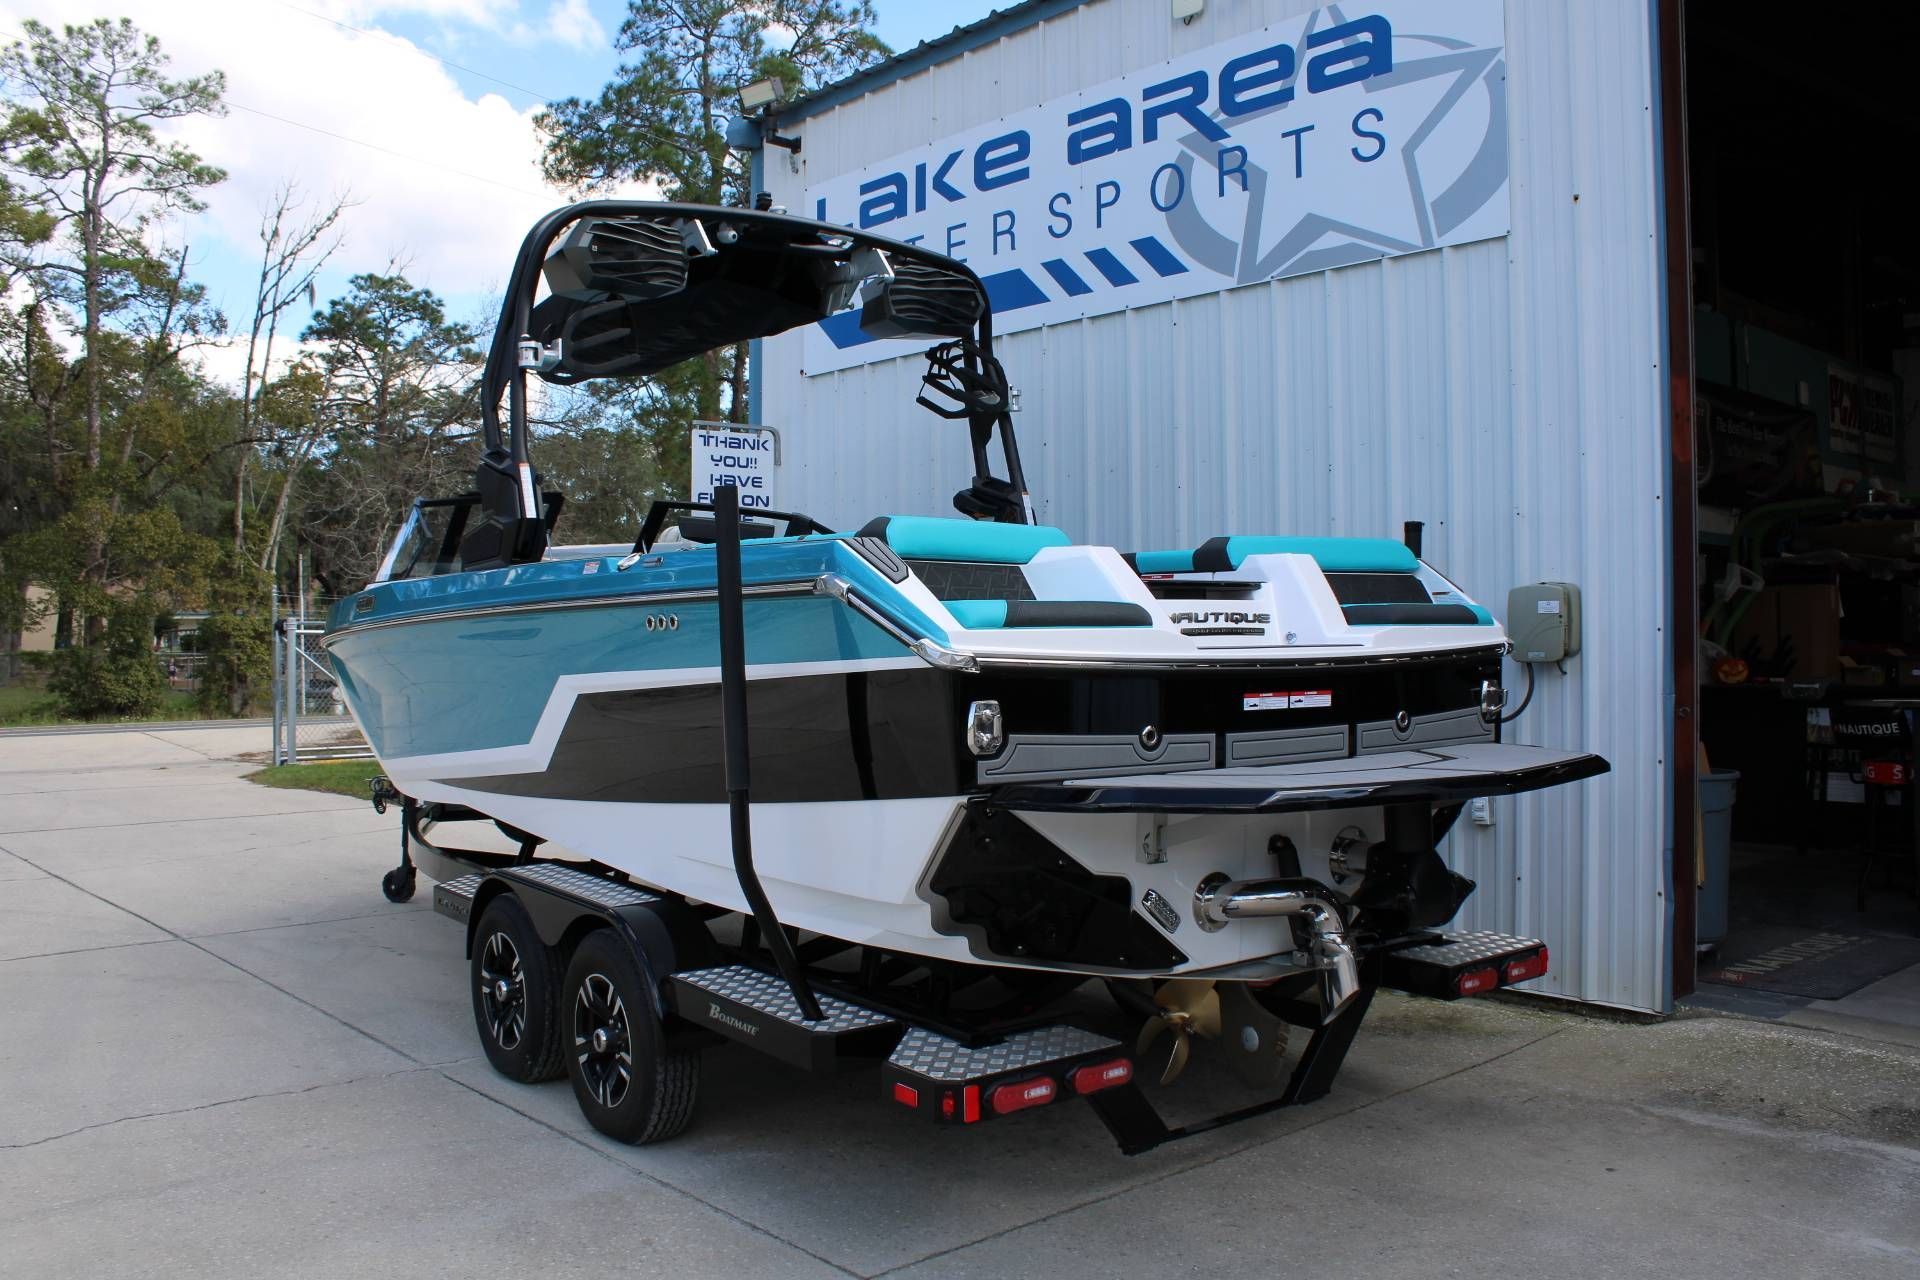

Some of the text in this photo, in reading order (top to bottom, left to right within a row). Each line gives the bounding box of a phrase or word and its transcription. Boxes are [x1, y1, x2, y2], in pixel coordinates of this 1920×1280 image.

[903, 108, 1387, 265] ERSPORTS
[711, 454, 757, 469] YOU!!
[742, 495, 770, 507] ON
[1169, 612, 1271, 624] NAUTIQUE
[1838, 722, 1900, 735] NAUTIQUE
[709, 1003, 757, 1036] BOATMATE
